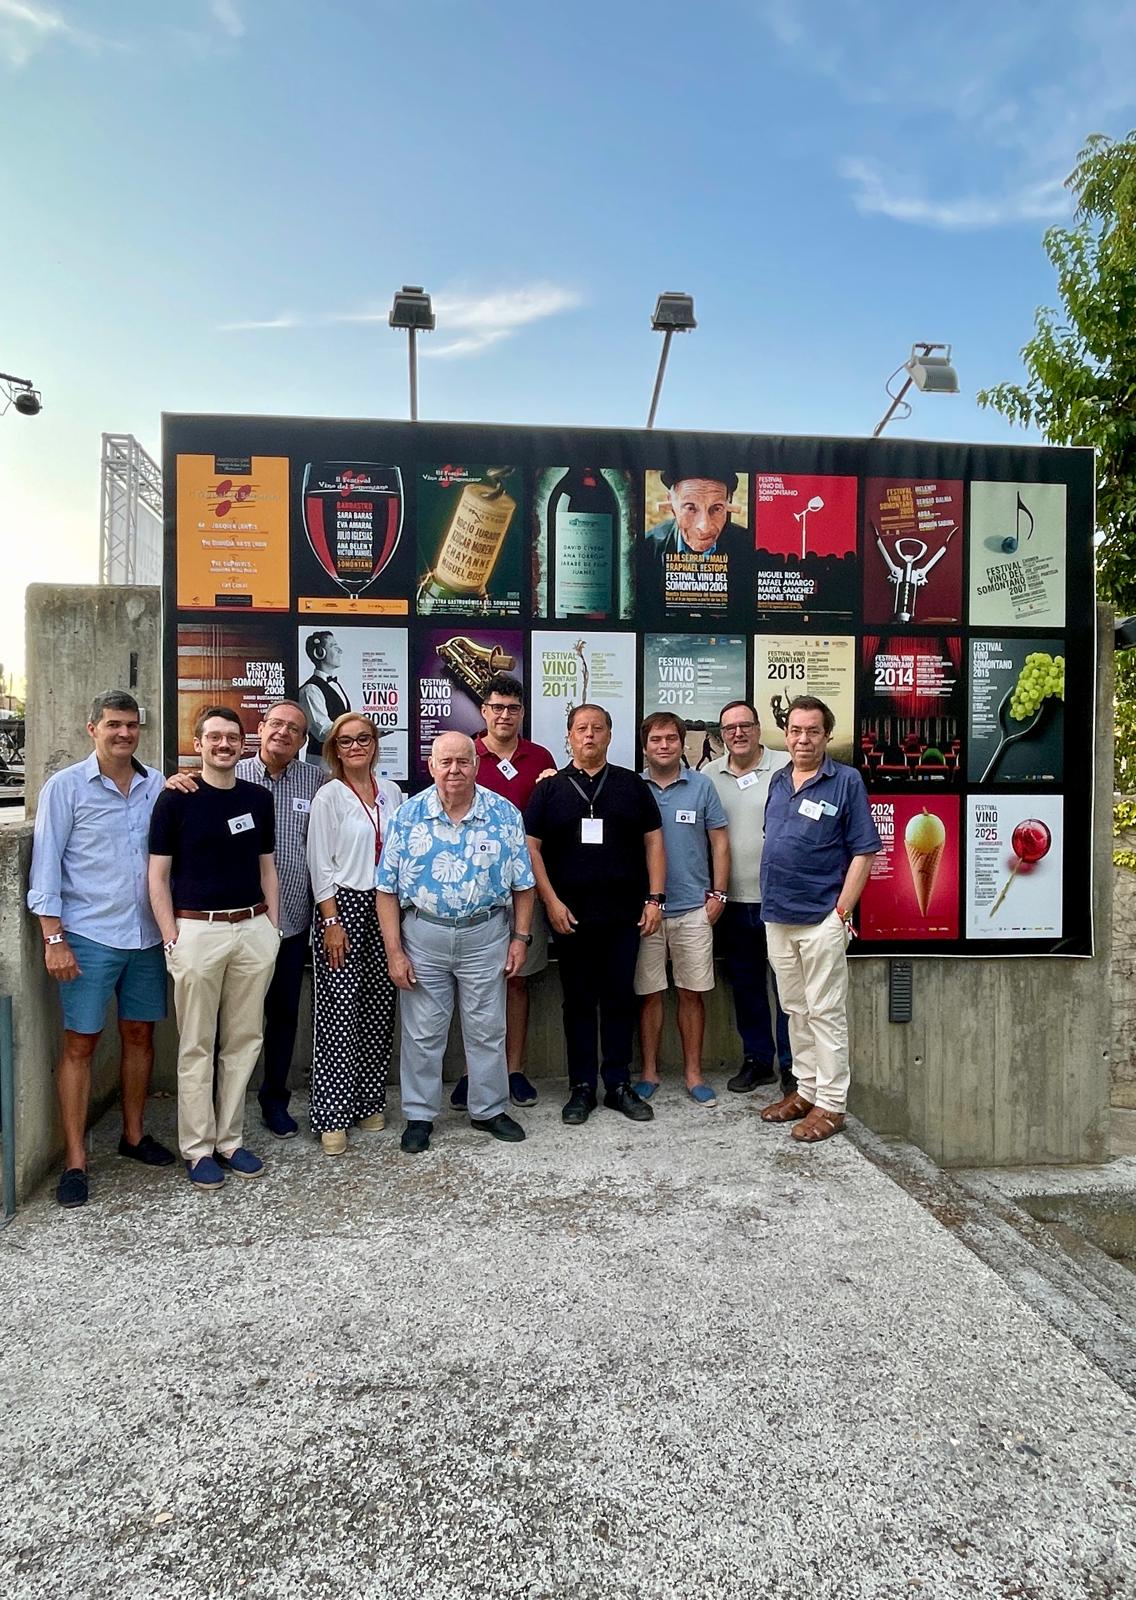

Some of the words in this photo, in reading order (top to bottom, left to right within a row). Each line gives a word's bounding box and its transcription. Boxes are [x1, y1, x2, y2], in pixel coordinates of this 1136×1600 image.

[351, 531, 373, 540] IGLESIAS
[447, 544, 490, 569] CHAYANNE
[670, 563, 698, 571] RAPHAEL
[704, 564, 728, 572] ESTOPA
[986, 561, 1022, 576] FESTIVAL
[666, 572, 696, 580] FESTIVAL
[697, 573, 713, 581] VINO
[715, 573, 728, 581] DEL
[988, 572, 1007, 584] VINO
[1009, 569, 1024, 579] DEL
[666, 581, 709, 591] SOMONTANO
[709, 582, 727, 591] 2004
[783, 579, 815, 587] AMARGO
[977, 577, 1025, 596] SOMONTANO
[1009, 584, 1027, 595] 2007
[973, 642, 1003, 651] FESTIVAL
[542, 652, 577, 660] FESTIVAL
[973, 651, 989, 659] VINO
[246, 662, 285, 671] FESTIVAL
[658, 657, 695, 666] FESTIVAL
[973, 660, 1012, 670] SOMONTANO
[543, 661, 576, 675] VINO
[768, 664, 805, 680] 2013
[973, 669, 989, 677] 2015
[247, 671, 266, 679] VINO
[269, 671, 285, 679] DEL
[659, 667, 694, 682] VINO
[875, 669, 914, 685] 2014
[232, 678, 285, 687] SOMONTANO
[420, 686, 451, 698] VINO
[543, 682, 577, 697] 2011
[363, 691, 398, 705] VINO
[658, 690, 694, 704] 2012
[420, 704, 451, 717] 2010
[870, 804, 894, 815] 2024
[975, 811, 998, 822] VINO
[875, 823, 894, 834] INO
[975, 829, 998, 840] 2025
